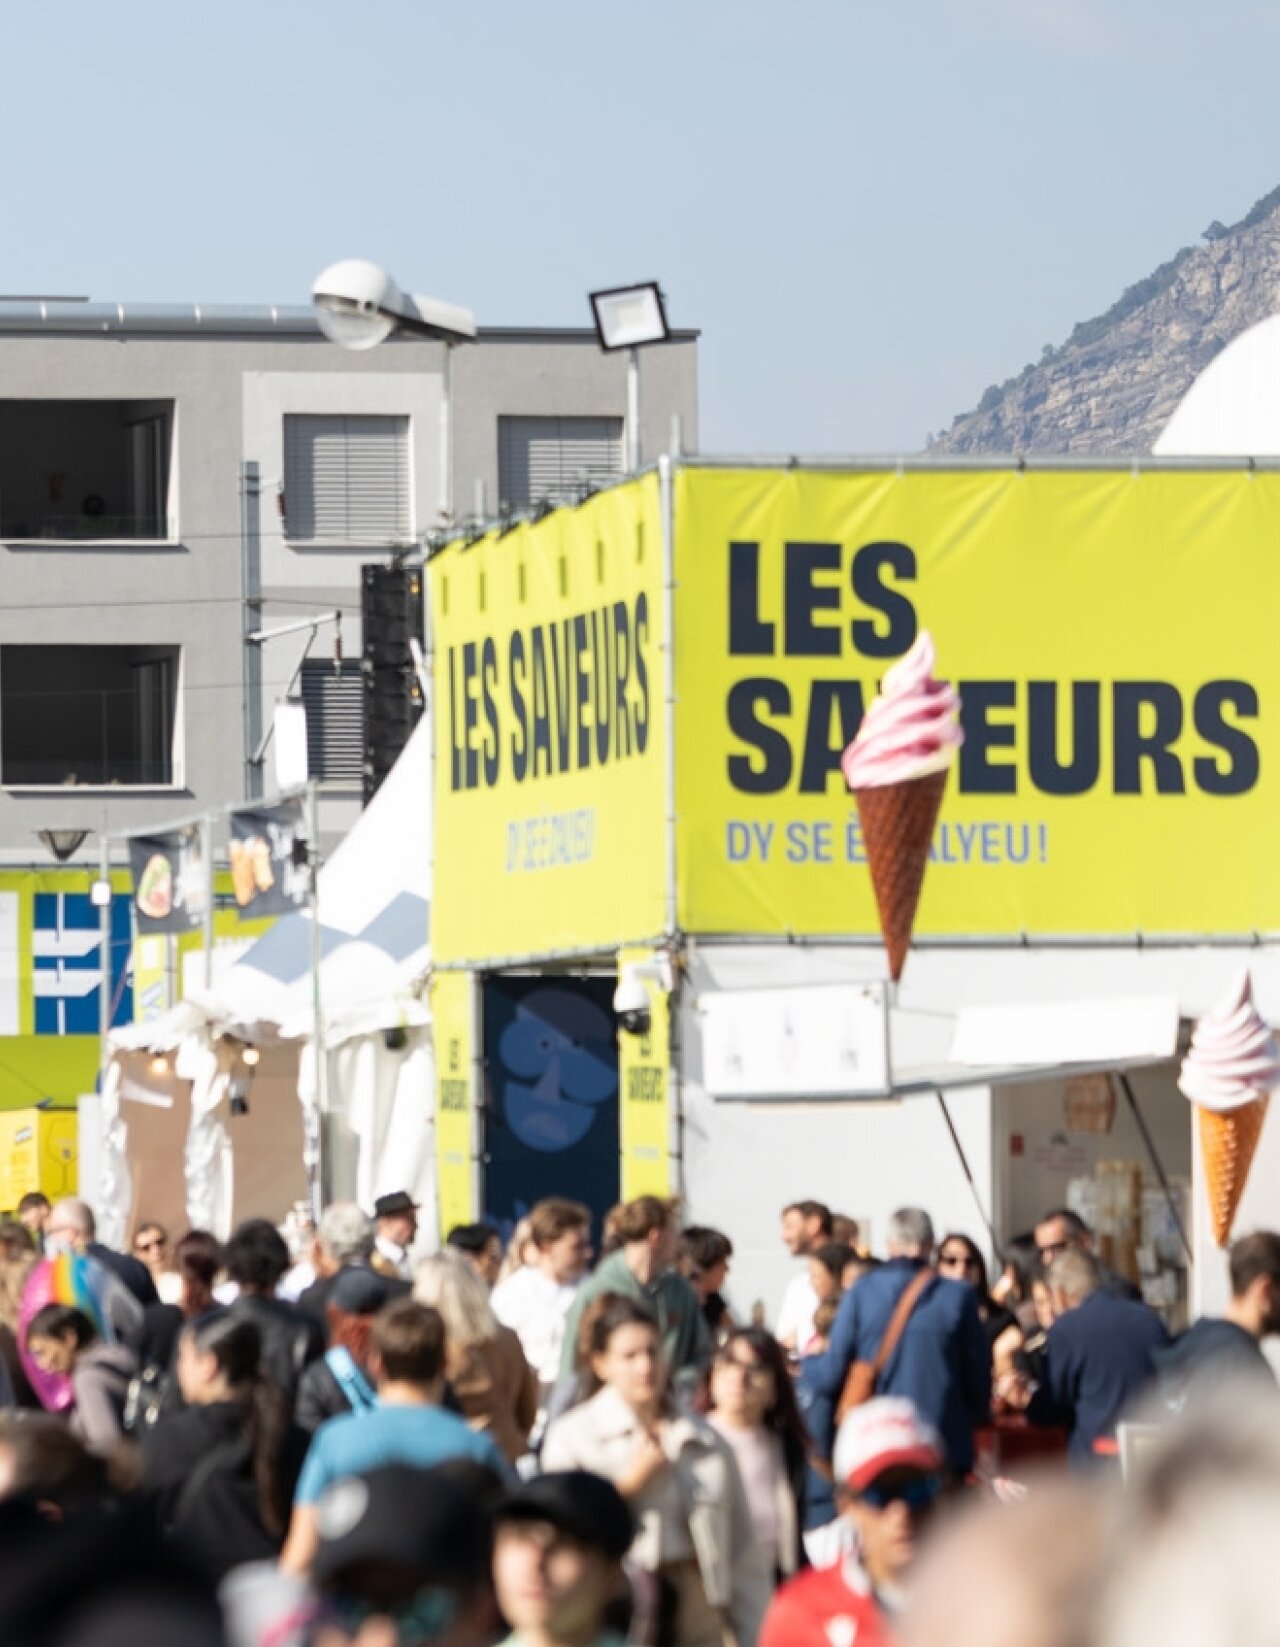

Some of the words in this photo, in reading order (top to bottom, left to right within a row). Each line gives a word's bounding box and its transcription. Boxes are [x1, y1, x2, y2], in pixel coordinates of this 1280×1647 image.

[727, 540, 918, 659] LES
[448, 635, 501, 793] LES
[509, 590, 650, 784] SAVEURS
[726, 676, 1260, 797] SAEURS
[726, 821, 775, 862] DY
[785, 821, 833, 862] SE
